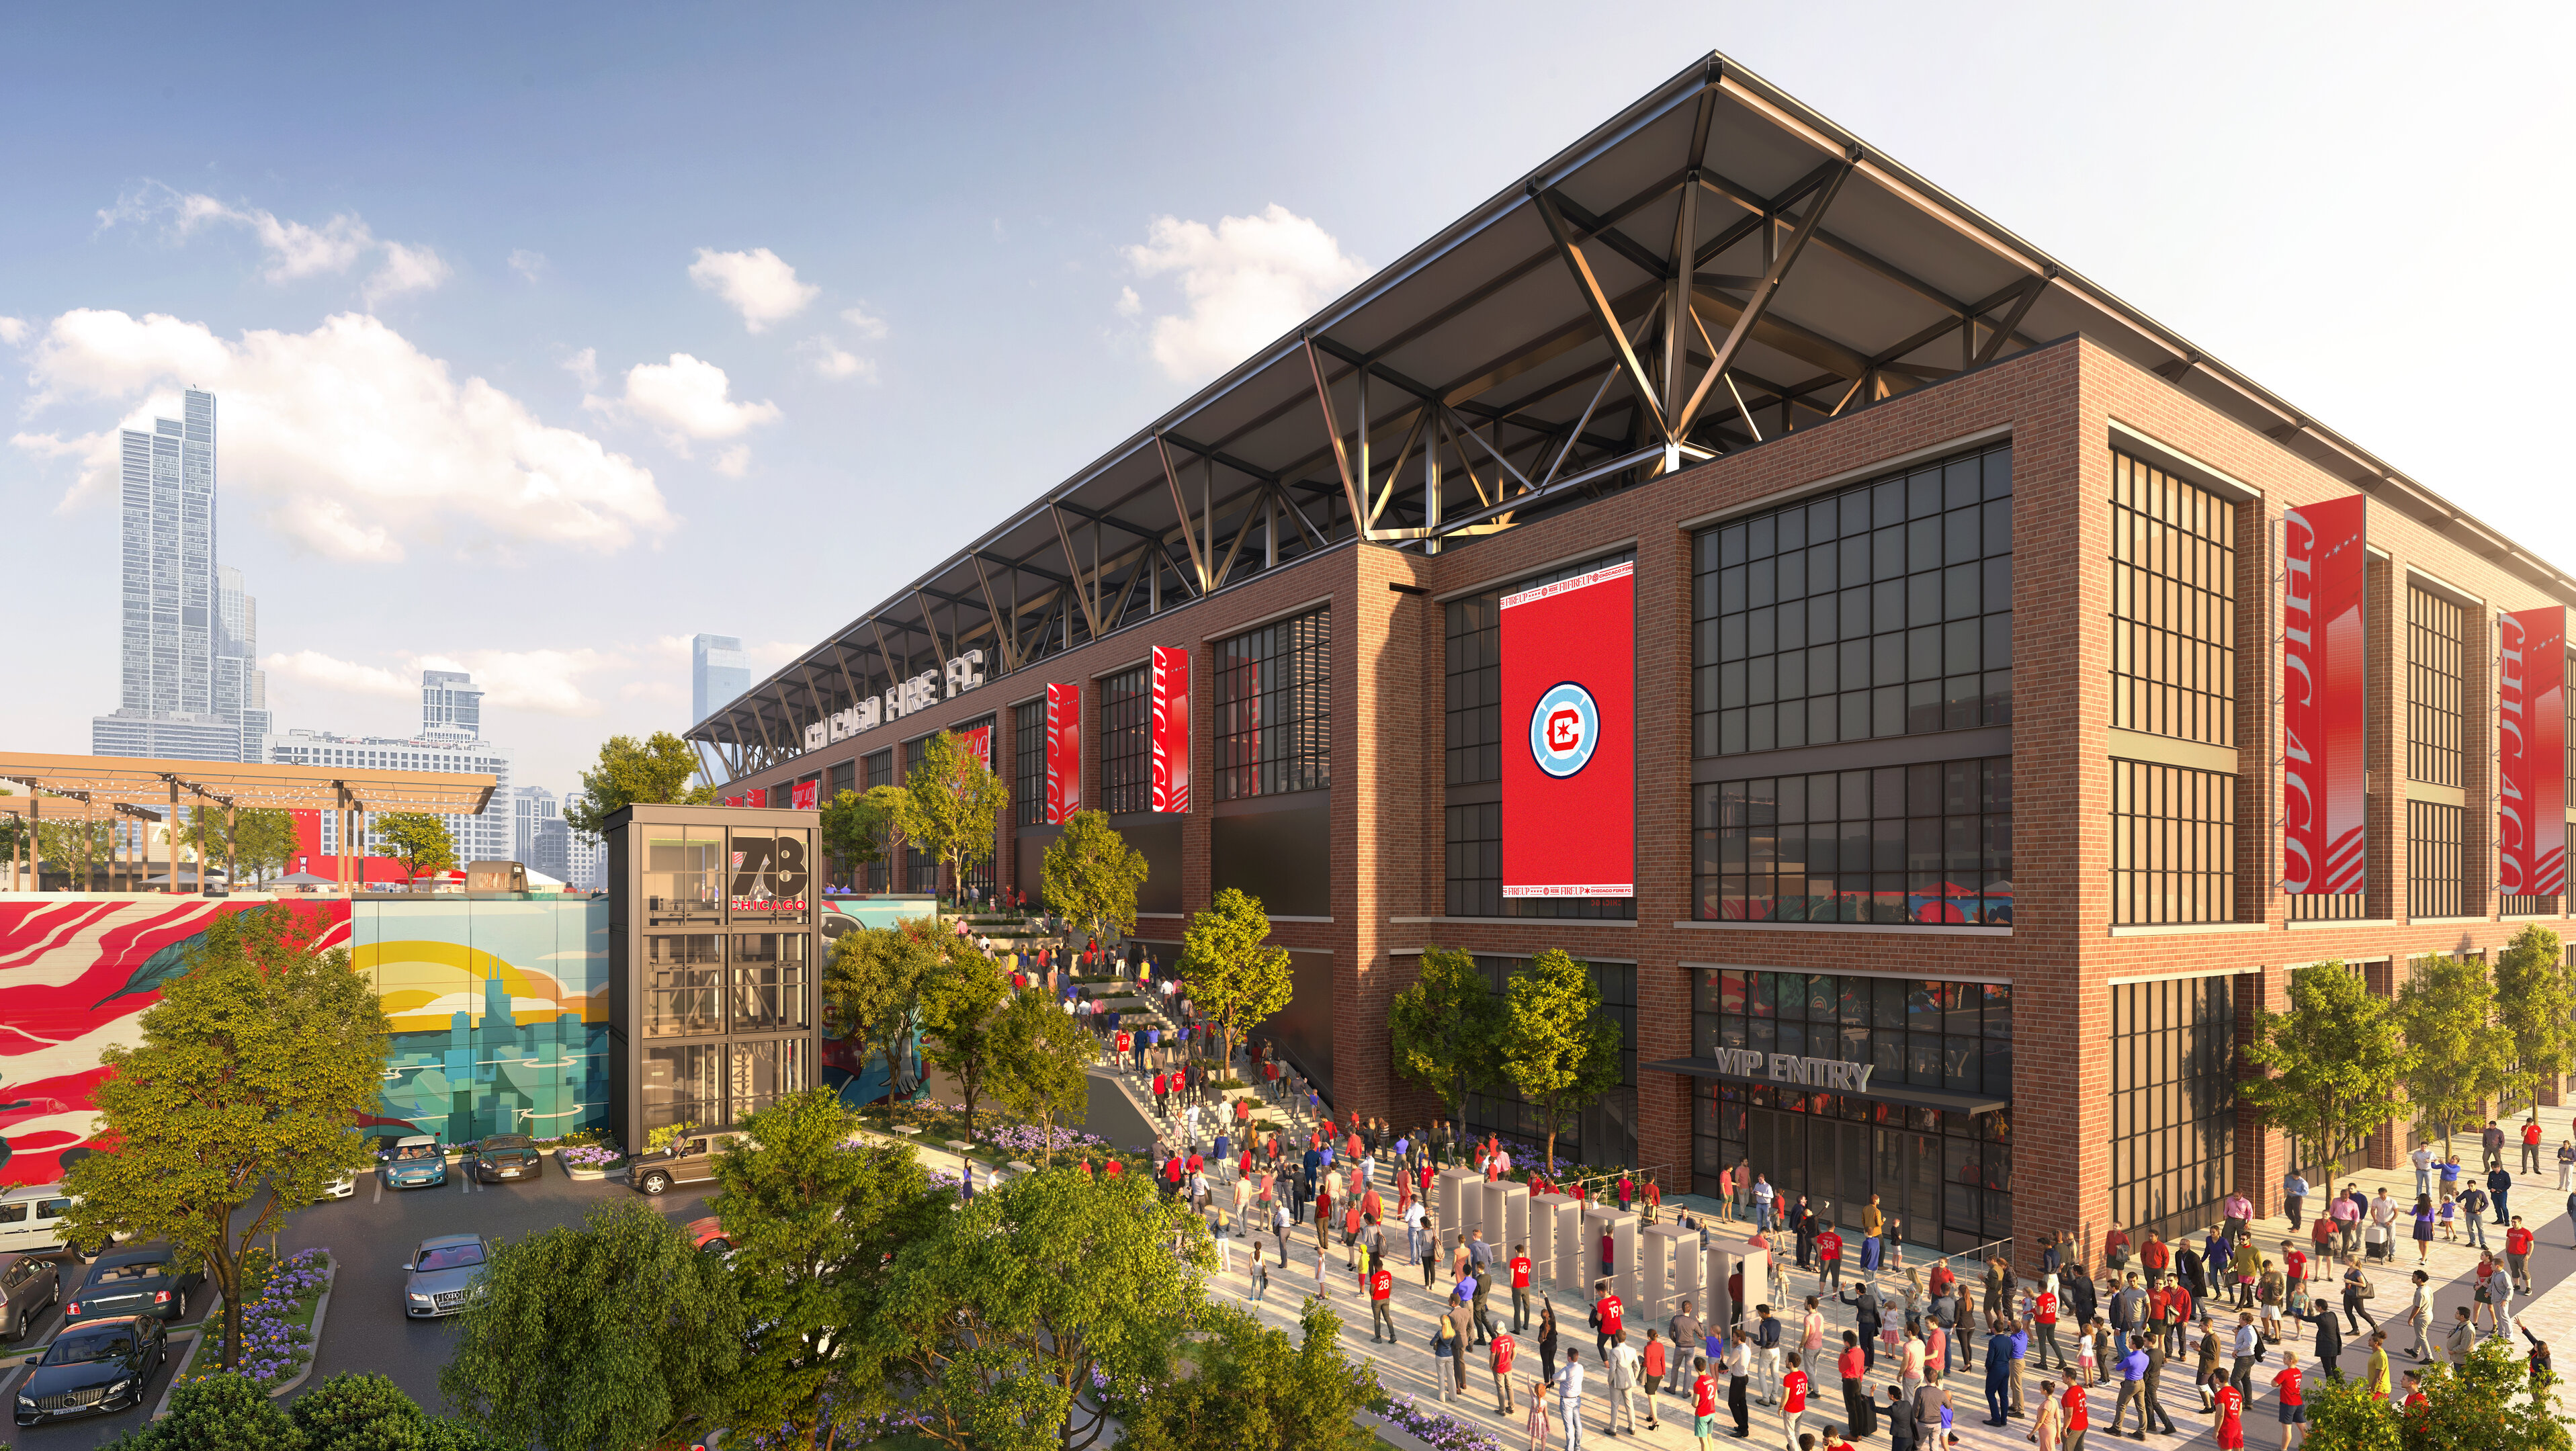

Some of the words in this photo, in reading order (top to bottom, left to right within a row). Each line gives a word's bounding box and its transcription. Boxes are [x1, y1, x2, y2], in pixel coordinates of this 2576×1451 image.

[805, 696, 880, 753] CHICAGO
[886, 669, 938, 721] FIRE
[947, 650, 983, 698] FC
[2284, 510, 2314, 893] CHICAGO
[1152, 646, 1167, 812] CHICAGO
[1047, 683, 1060, 824] CHICAGO
[2500, 613, 2525, 895] CHICAGO
[732, 836, 808, 897] 78
[732, 900, 806, 910] CHICAGO
[1714, 1047, 1762, 1077] VIP
[1769, 1053, 1875, 1092] ENTRY
[1822, 1239, 1835, 1250] 38
[1518, 1266, 1527, 1274] 48
[1378, 1279, 1389, 1290] 28
[1608, 1306, 1619, 1318] 19
[2046, 1302, 2055, 1313] 28
[1500, 1342, 1510, 1353] 77
[1707, 1384, 1714, 1399] 2
[1796, 1383, 1805, 1395] 23
